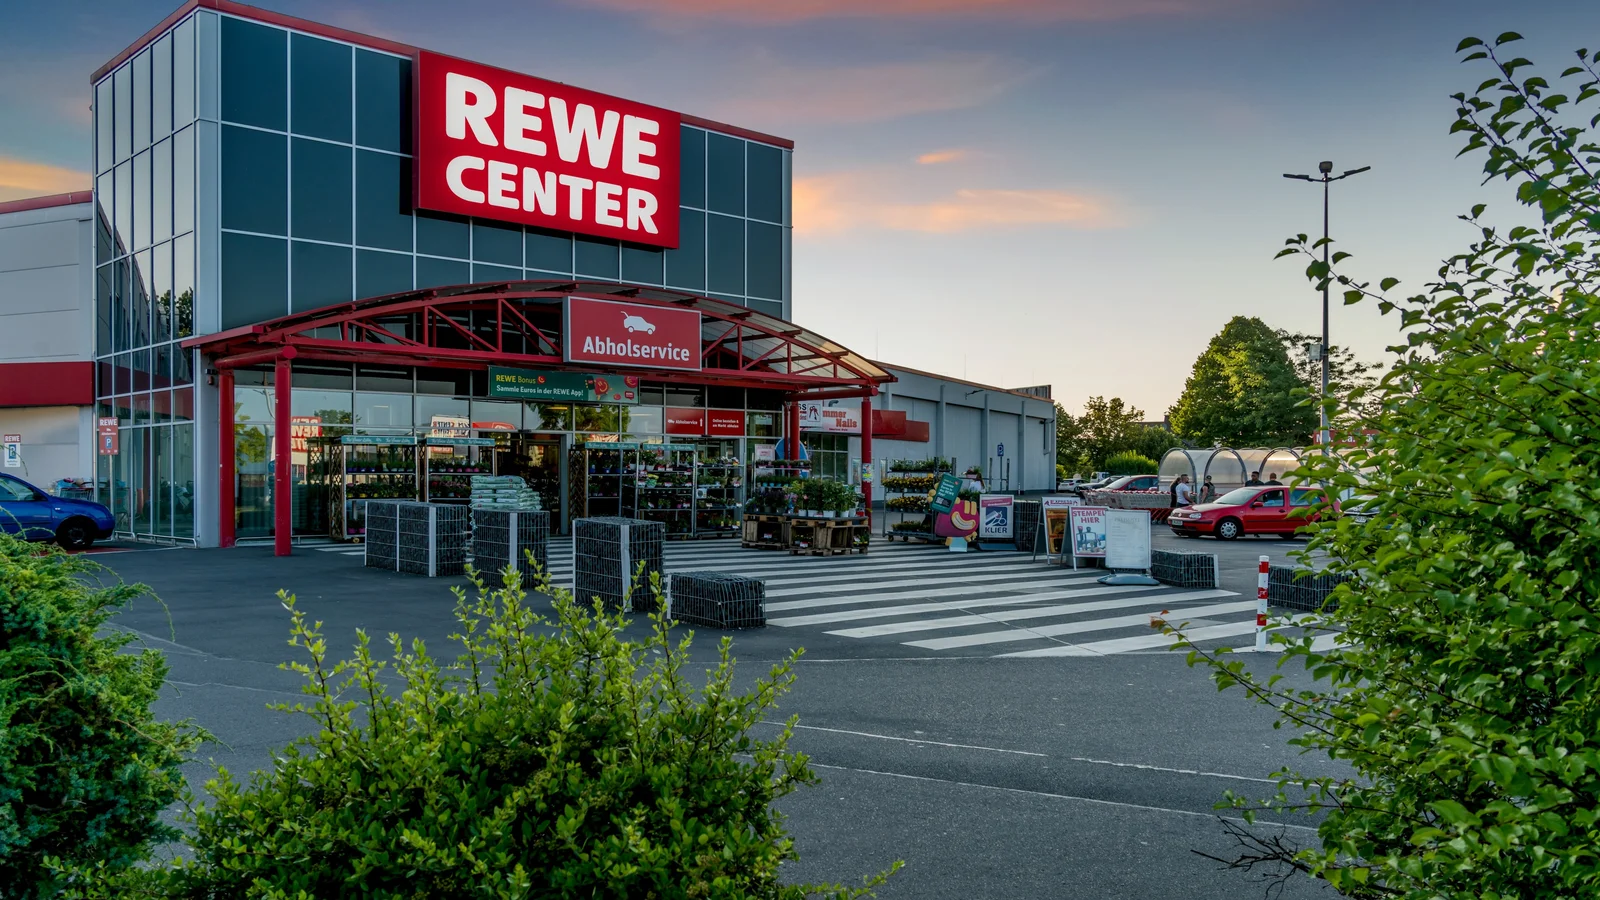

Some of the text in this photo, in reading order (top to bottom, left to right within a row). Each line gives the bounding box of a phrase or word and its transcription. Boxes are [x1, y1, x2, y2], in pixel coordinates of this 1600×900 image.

[445, 71, 660, 180] REWE
[445, 155, 659, 235] CENTER
[582, 335, 690, 361] Abholservice
[495, 374, 536, 384] REWE Bonus
[570, 389, 584, 397] App!
[99, 418, 118, 426] REWE
[836, 418, 857, 428] Nails
